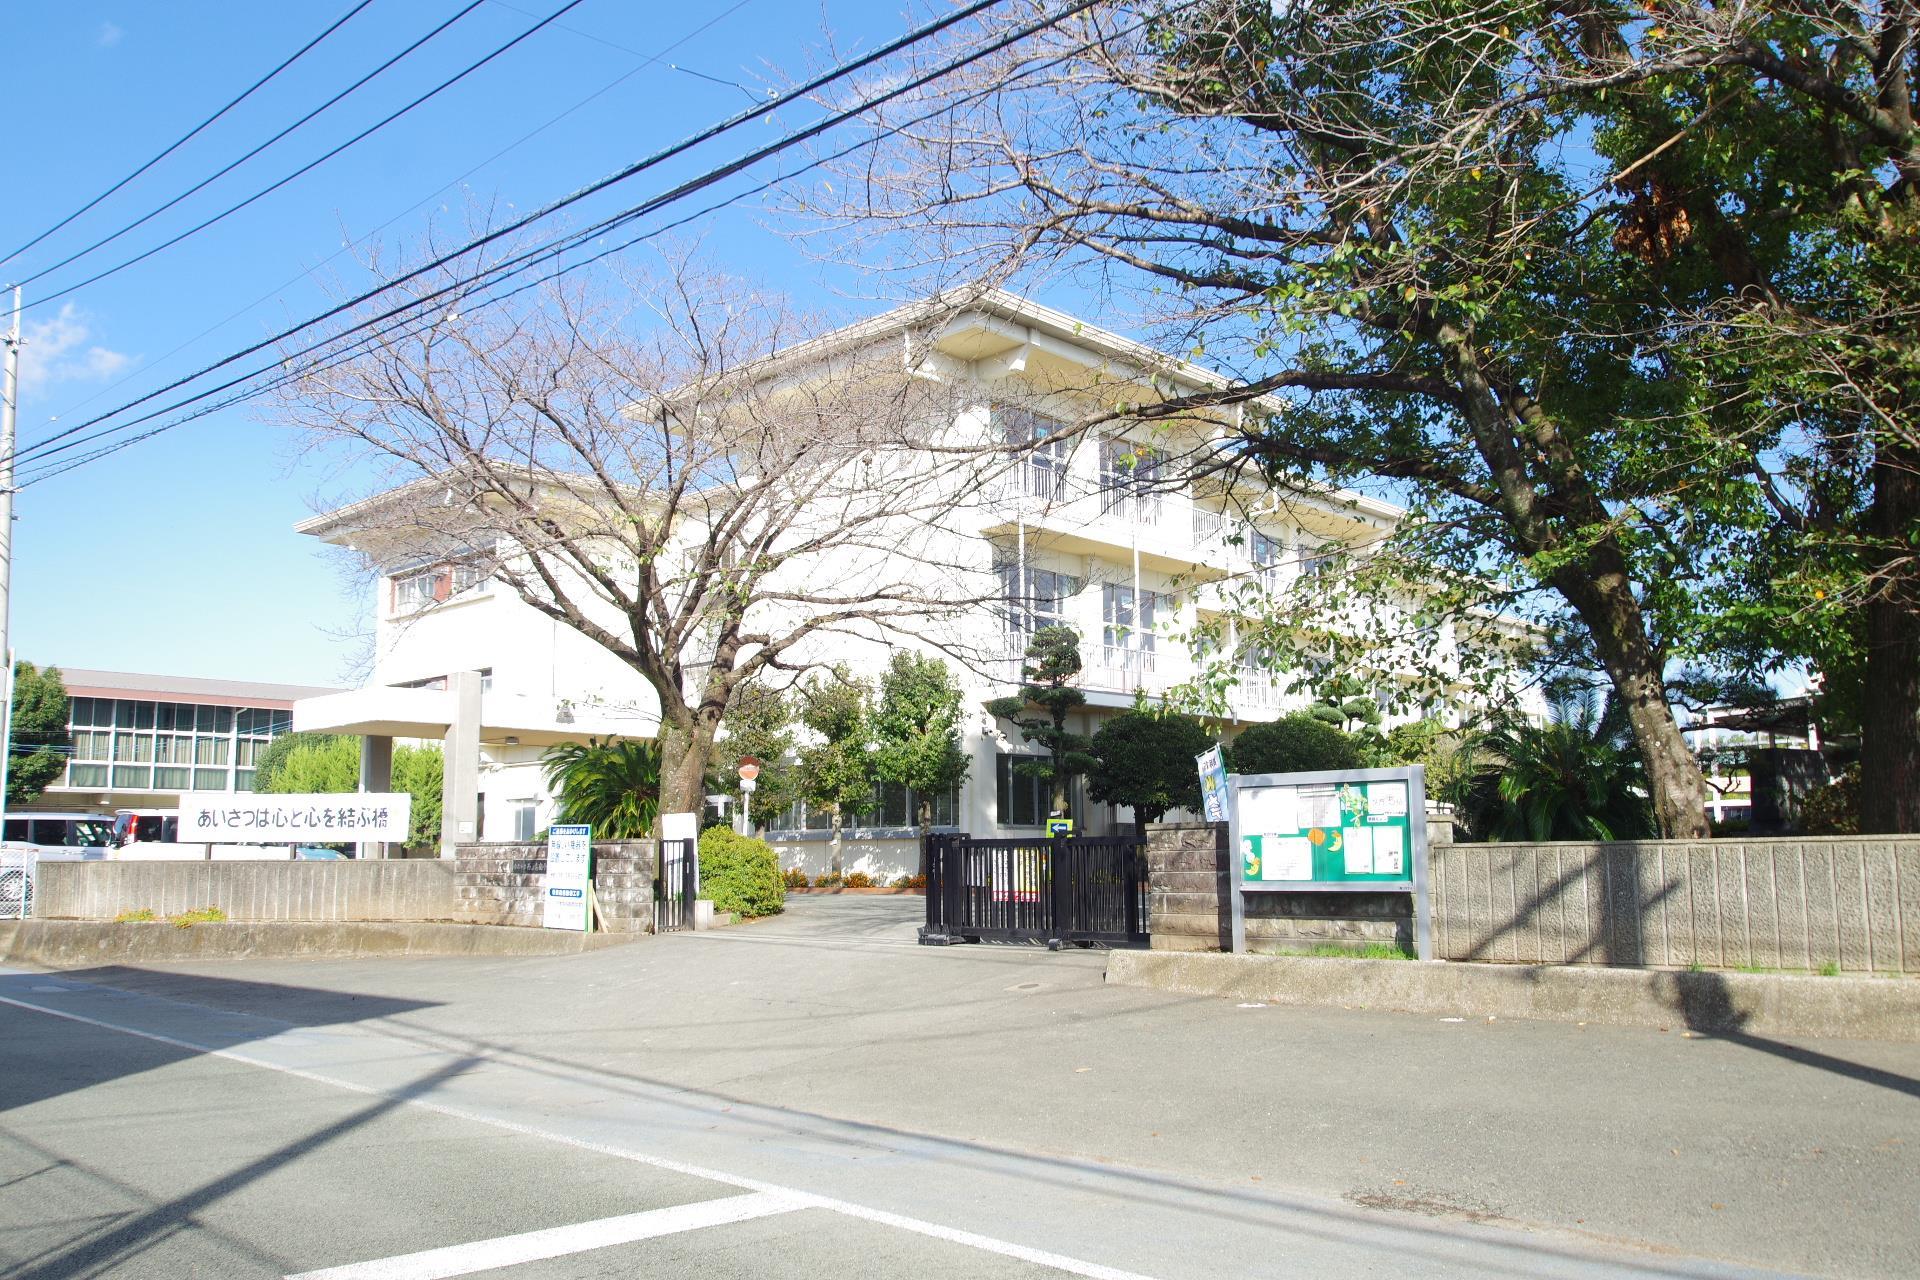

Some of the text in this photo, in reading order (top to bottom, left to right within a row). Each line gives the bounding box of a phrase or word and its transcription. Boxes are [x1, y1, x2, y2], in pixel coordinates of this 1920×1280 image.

[197, 806, 389, 828] あいさつは心と心を結ぶ橋
